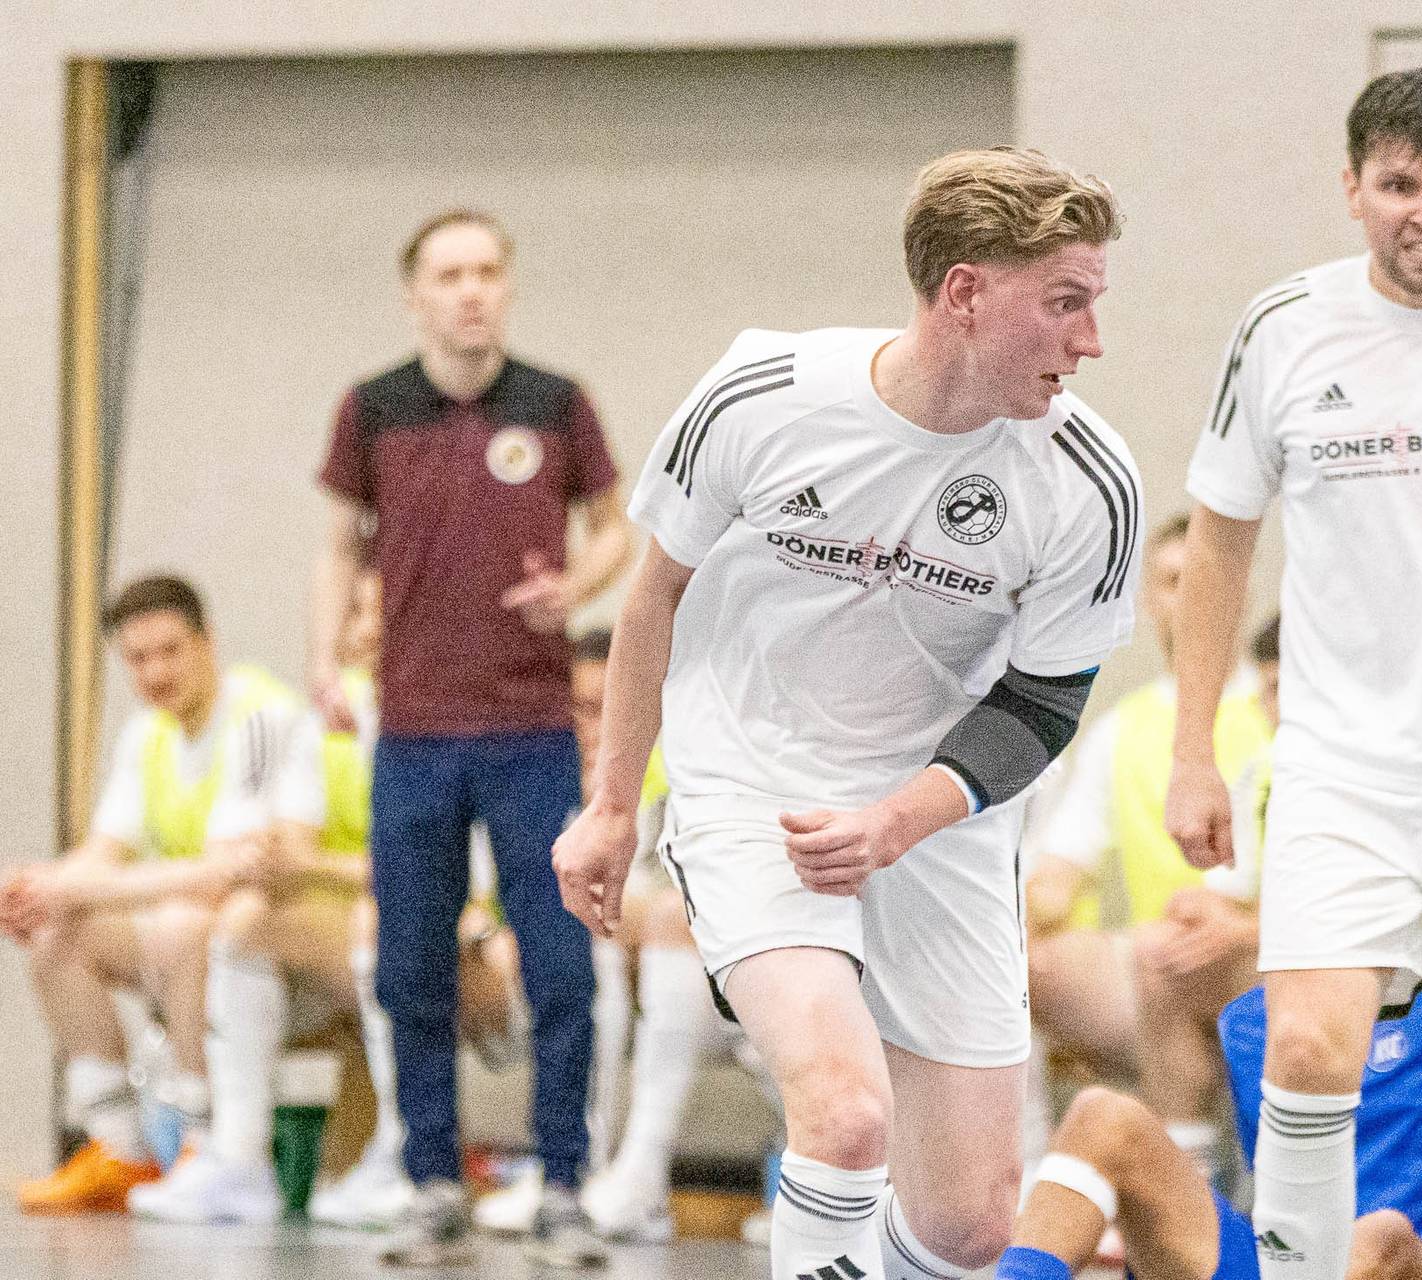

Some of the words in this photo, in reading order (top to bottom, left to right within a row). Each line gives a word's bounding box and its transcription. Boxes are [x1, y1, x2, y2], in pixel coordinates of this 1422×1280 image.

[1311, 436, 1394, 461] DÖNER
[780, 504, 829, 520] adidas
[767, 532, 864, 566] DÖNER
[874, 546, 995, 596] BROTHERS
